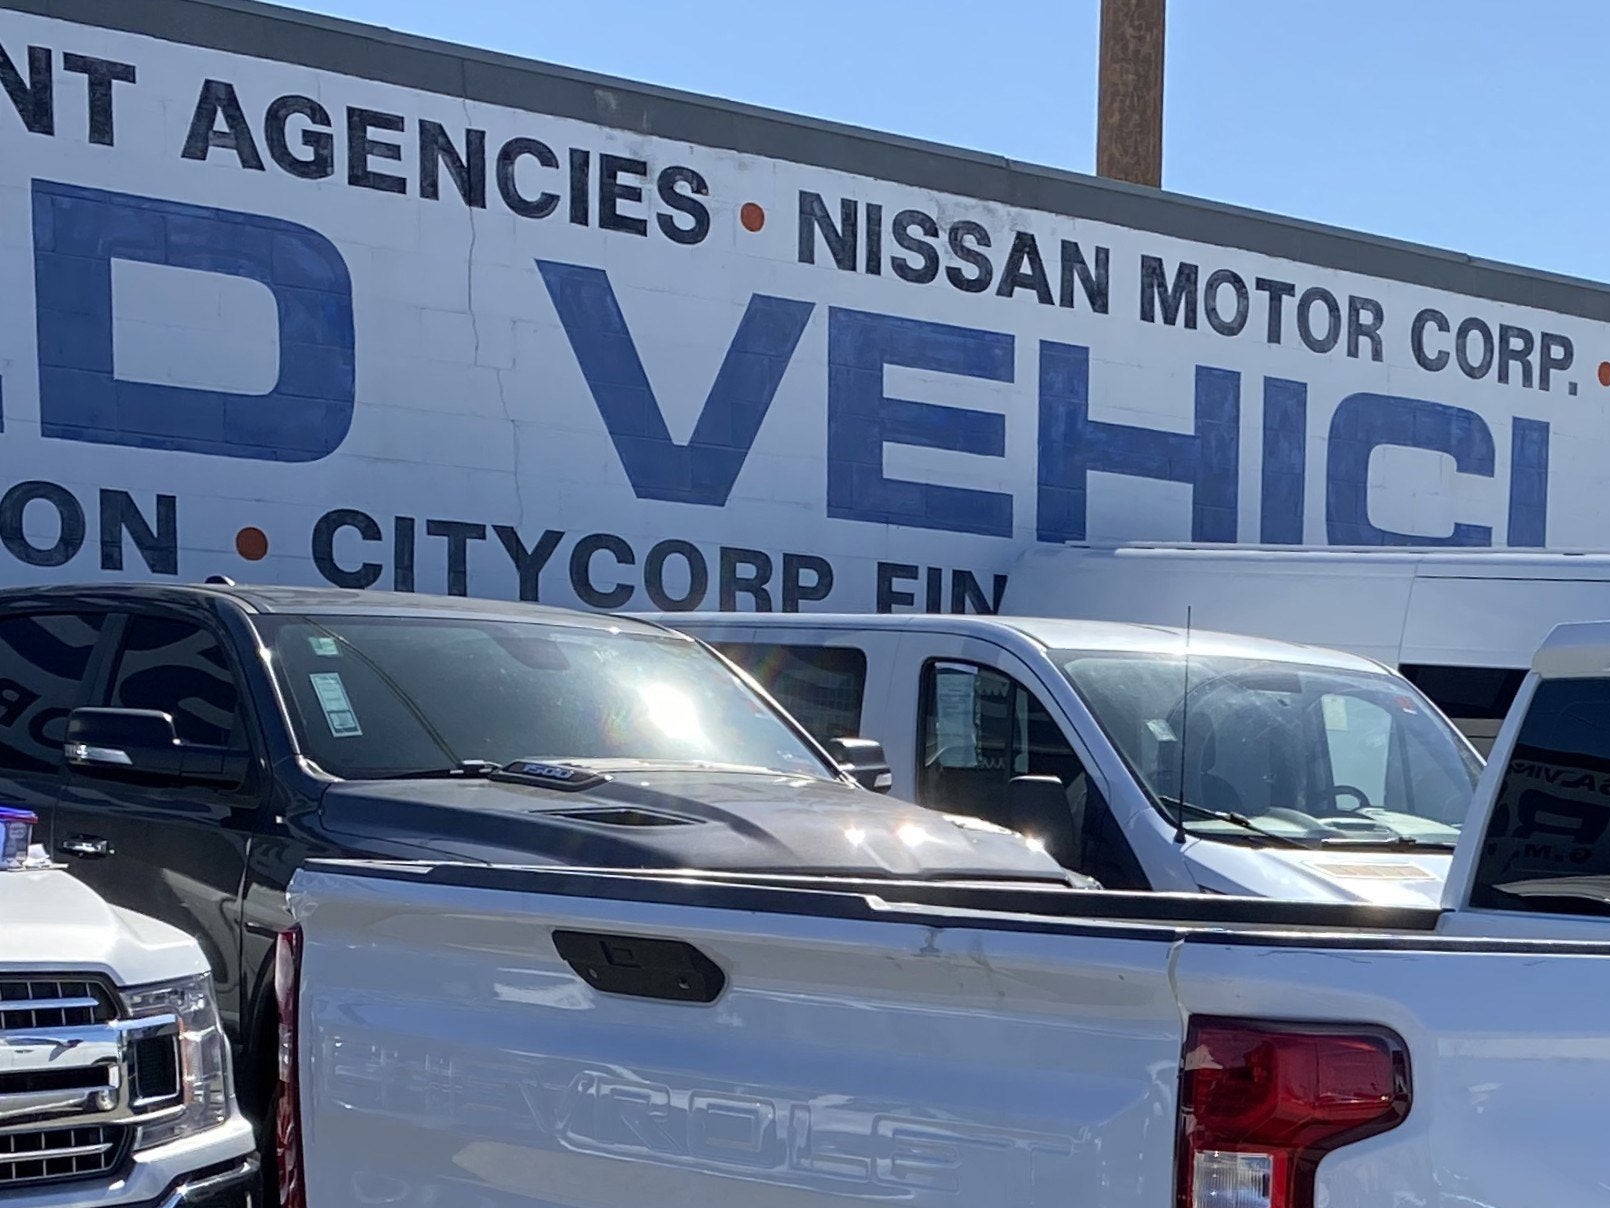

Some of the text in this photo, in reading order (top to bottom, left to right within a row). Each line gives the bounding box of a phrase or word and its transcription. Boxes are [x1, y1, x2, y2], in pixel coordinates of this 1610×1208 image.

[181, 78, 711, 245] AGENCIES
[798, 189, 1577, 395] NISSAN MOTOR CORP.
[0, 480, 178, 575] ON
[311, 508, 834, 613] CITYCORP
